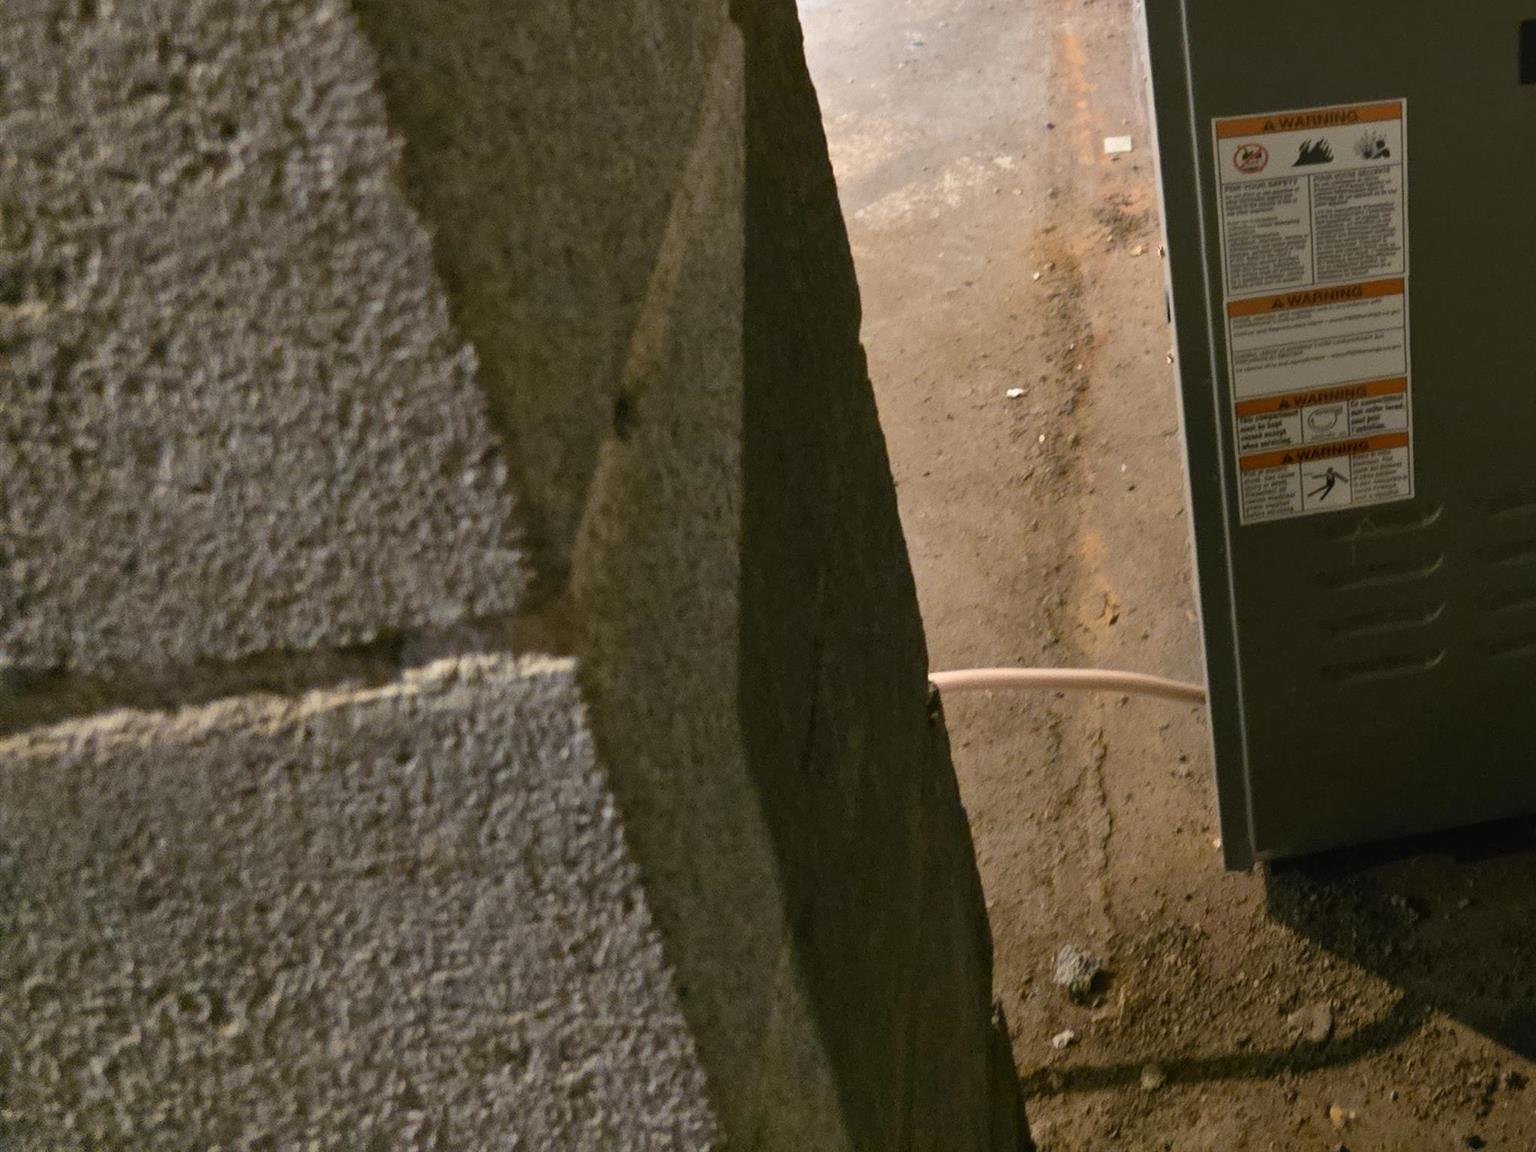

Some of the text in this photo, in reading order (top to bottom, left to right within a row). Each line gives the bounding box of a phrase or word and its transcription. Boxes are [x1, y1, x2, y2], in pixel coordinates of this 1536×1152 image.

[1280, 110, 1359, 131] WARNING
[1288, 287, 1363, 308] WARNING
[1295, 386, 1367, 407] WARNING
[1298, 441, 1369, 460] WARNING
